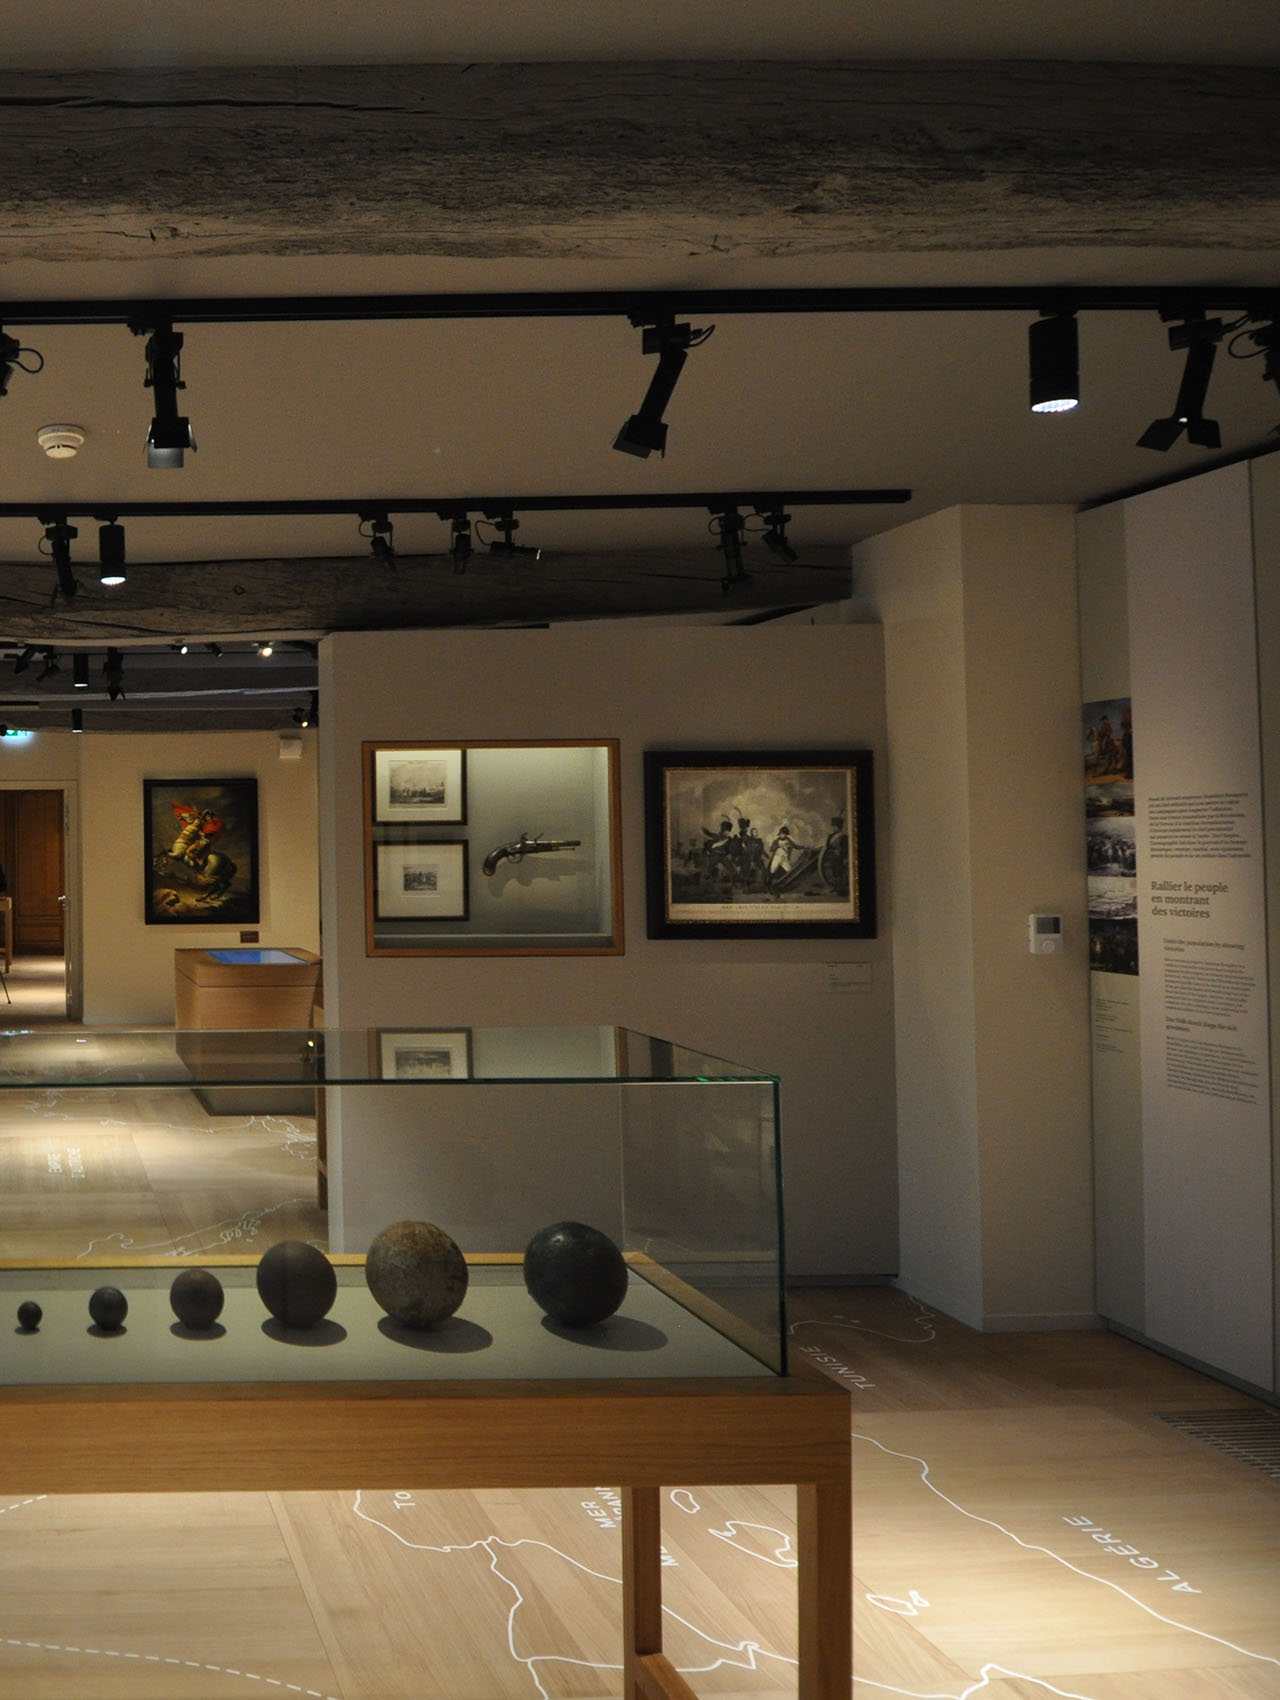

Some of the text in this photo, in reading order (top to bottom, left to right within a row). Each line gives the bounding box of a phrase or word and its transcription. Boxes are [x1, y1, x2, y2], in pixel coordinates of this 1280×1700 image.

[1151, 881, 1229, 895] Rallier le peuple
[1151, 895, 1210, 905] en montrant
[1151, 905, 1211, 919] des victoires
[800, 1346, 876, 1389] TUNISIE
[581, 1501, 617, 1528] MER
[1062, 1515, 1203, 1594] ALGÉRIE
